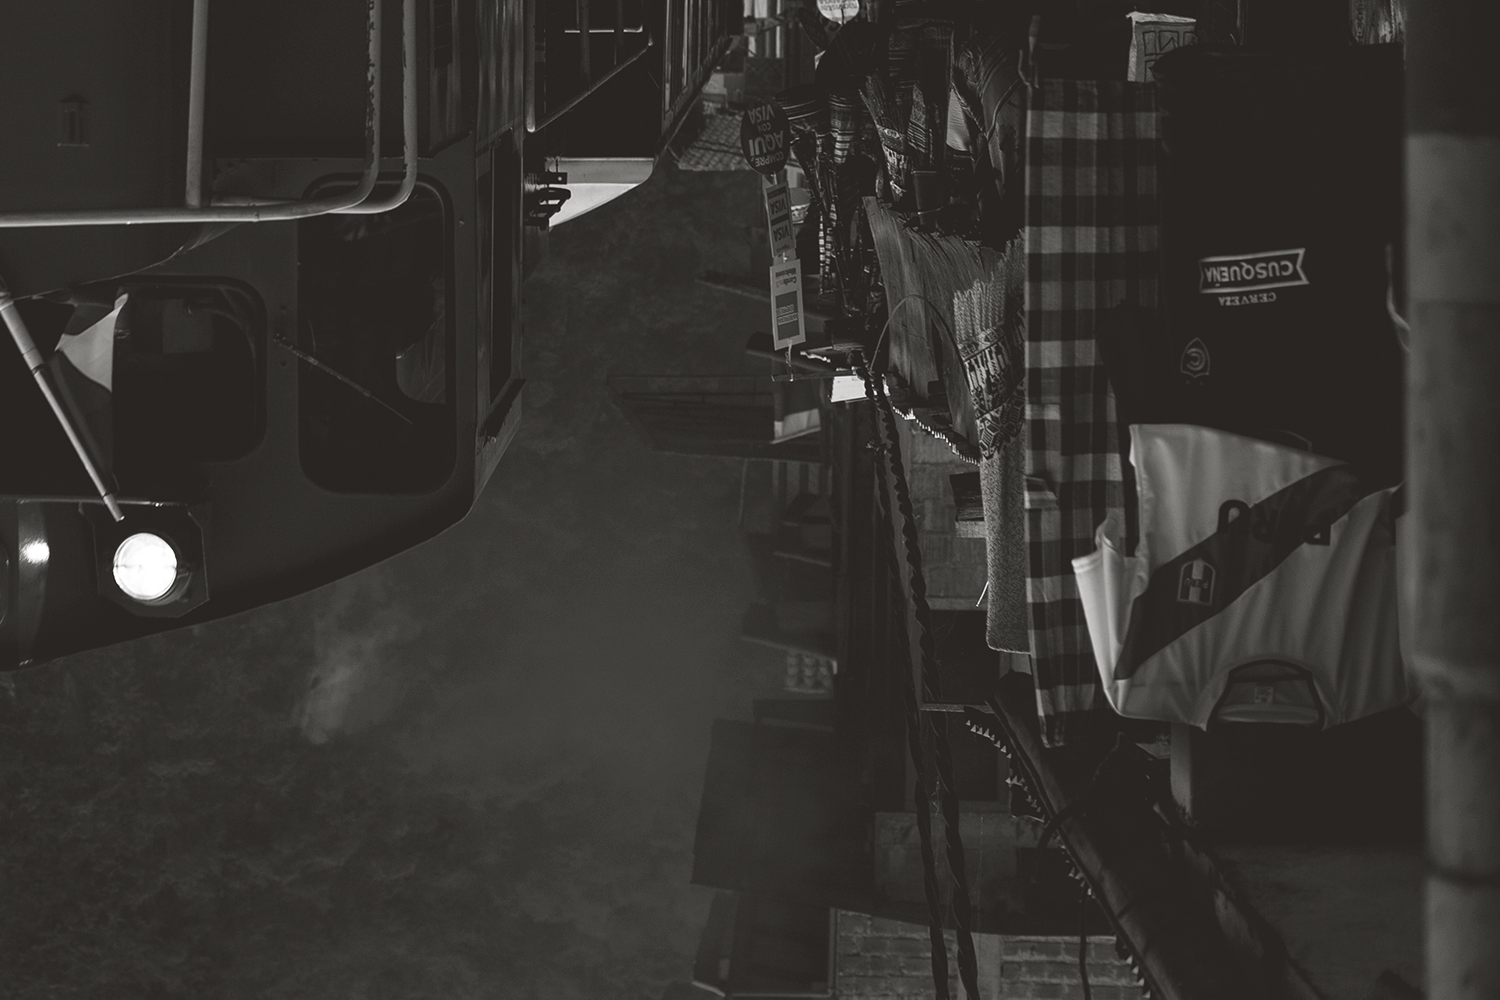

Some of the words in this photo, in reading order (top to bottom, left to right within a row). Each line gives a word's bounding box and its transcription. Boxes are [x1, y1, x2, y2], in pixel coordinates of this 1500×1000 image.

[747, 104, 776, 124] VISA
[757, 122, 772, 132] CON
[748, 130, 784, 162] AQUÍ
[755, 150, 784, 167] COMPRE
[770, 198, 786, 215] VISA
[773, 224, 790, 242] VISA
[1204, 260, 1294, 288] CUSQUEÑA
[1218, 292, 1277, 306] CERVEZA
[1216, 500, 1331, 546] PRU
[1184, 577, 1210, 589] PERU
